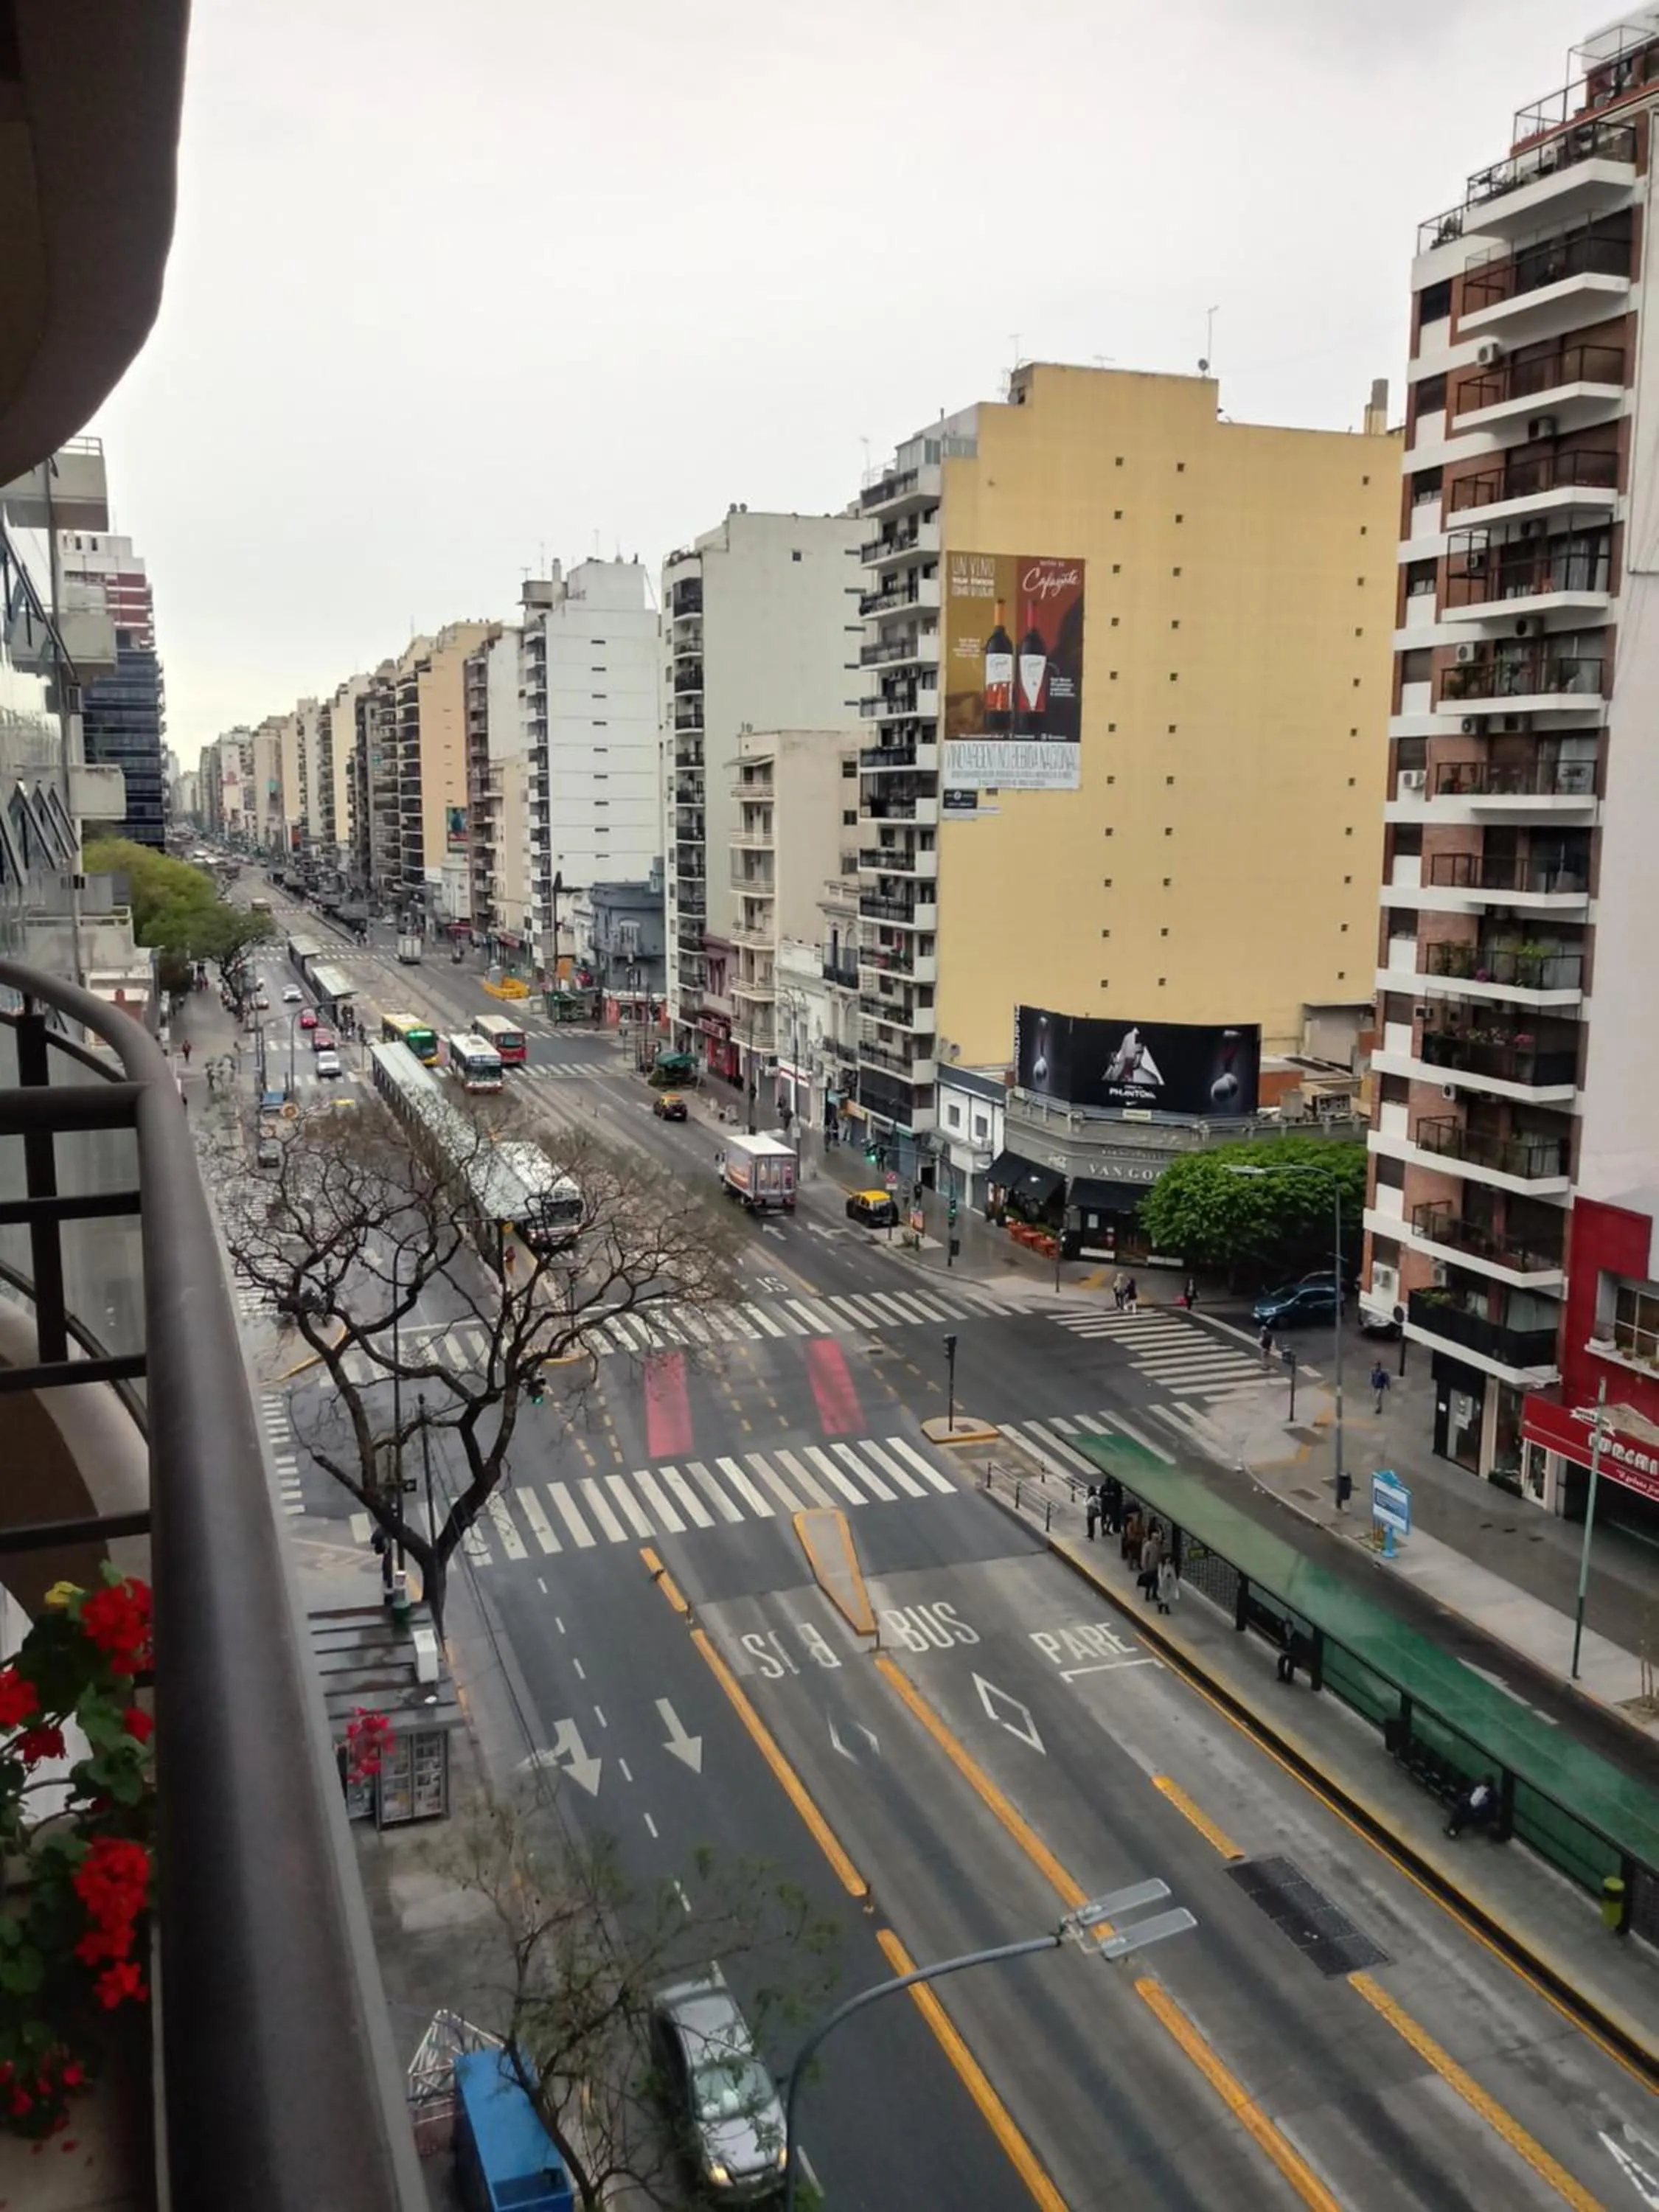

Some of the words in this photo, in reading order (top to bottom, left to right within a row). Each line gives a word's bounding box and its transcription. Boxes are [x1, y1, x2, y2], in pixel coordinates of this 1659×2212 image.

[1089, 1163, 1123, 1178] VAN
[881, 1601, 980, 1652] BUS
[1029, 1622, 1138, 1665] PARE
